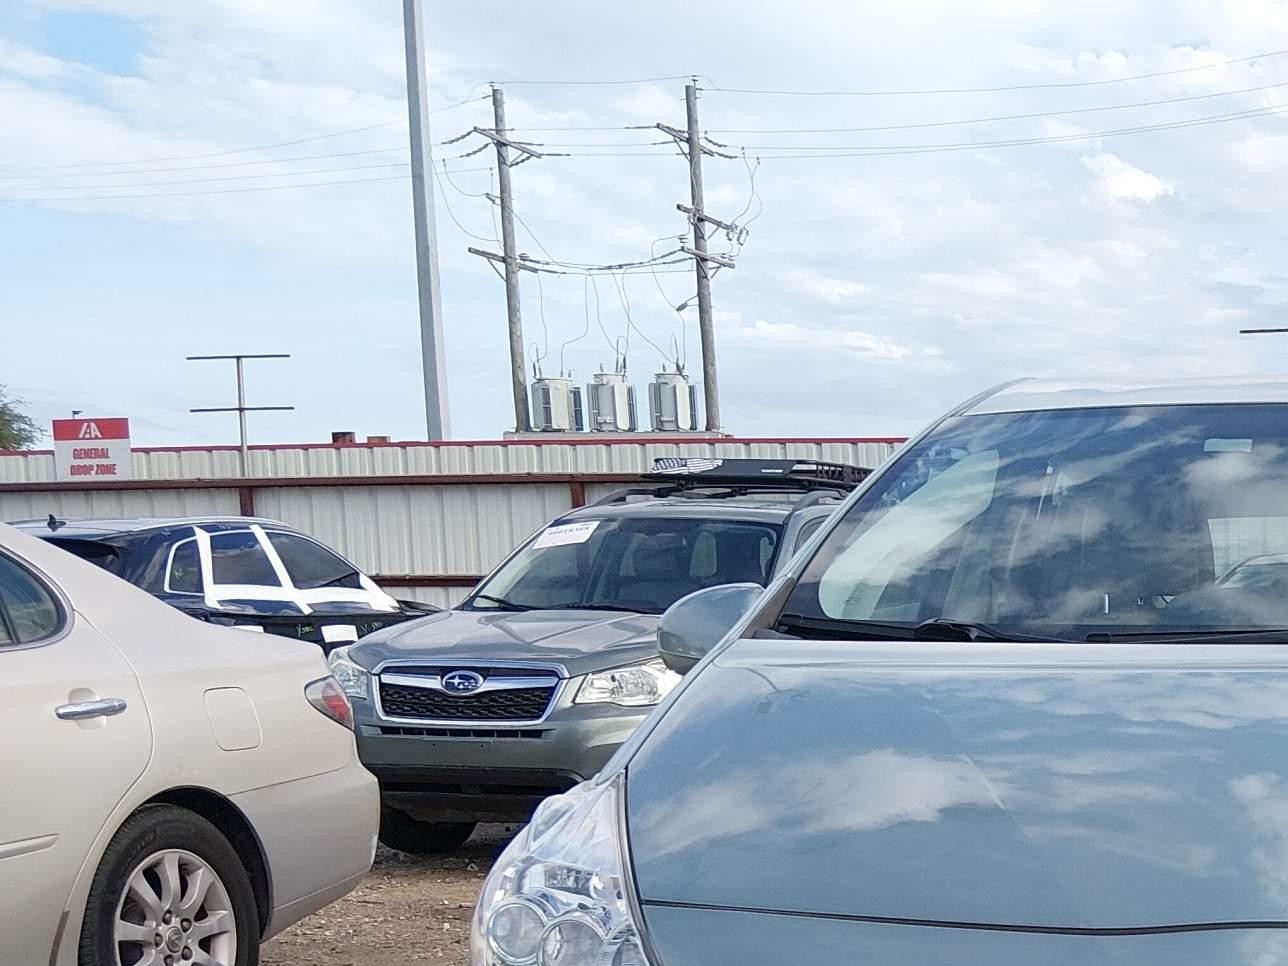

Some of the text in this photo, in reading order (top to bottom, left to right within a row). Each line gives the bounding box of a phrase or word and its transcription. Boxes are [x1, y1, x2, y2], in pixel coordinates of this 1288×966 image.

[73, 447, 109, 459] GENERAL
[70, 464, 117, 476] DROP ZONE
